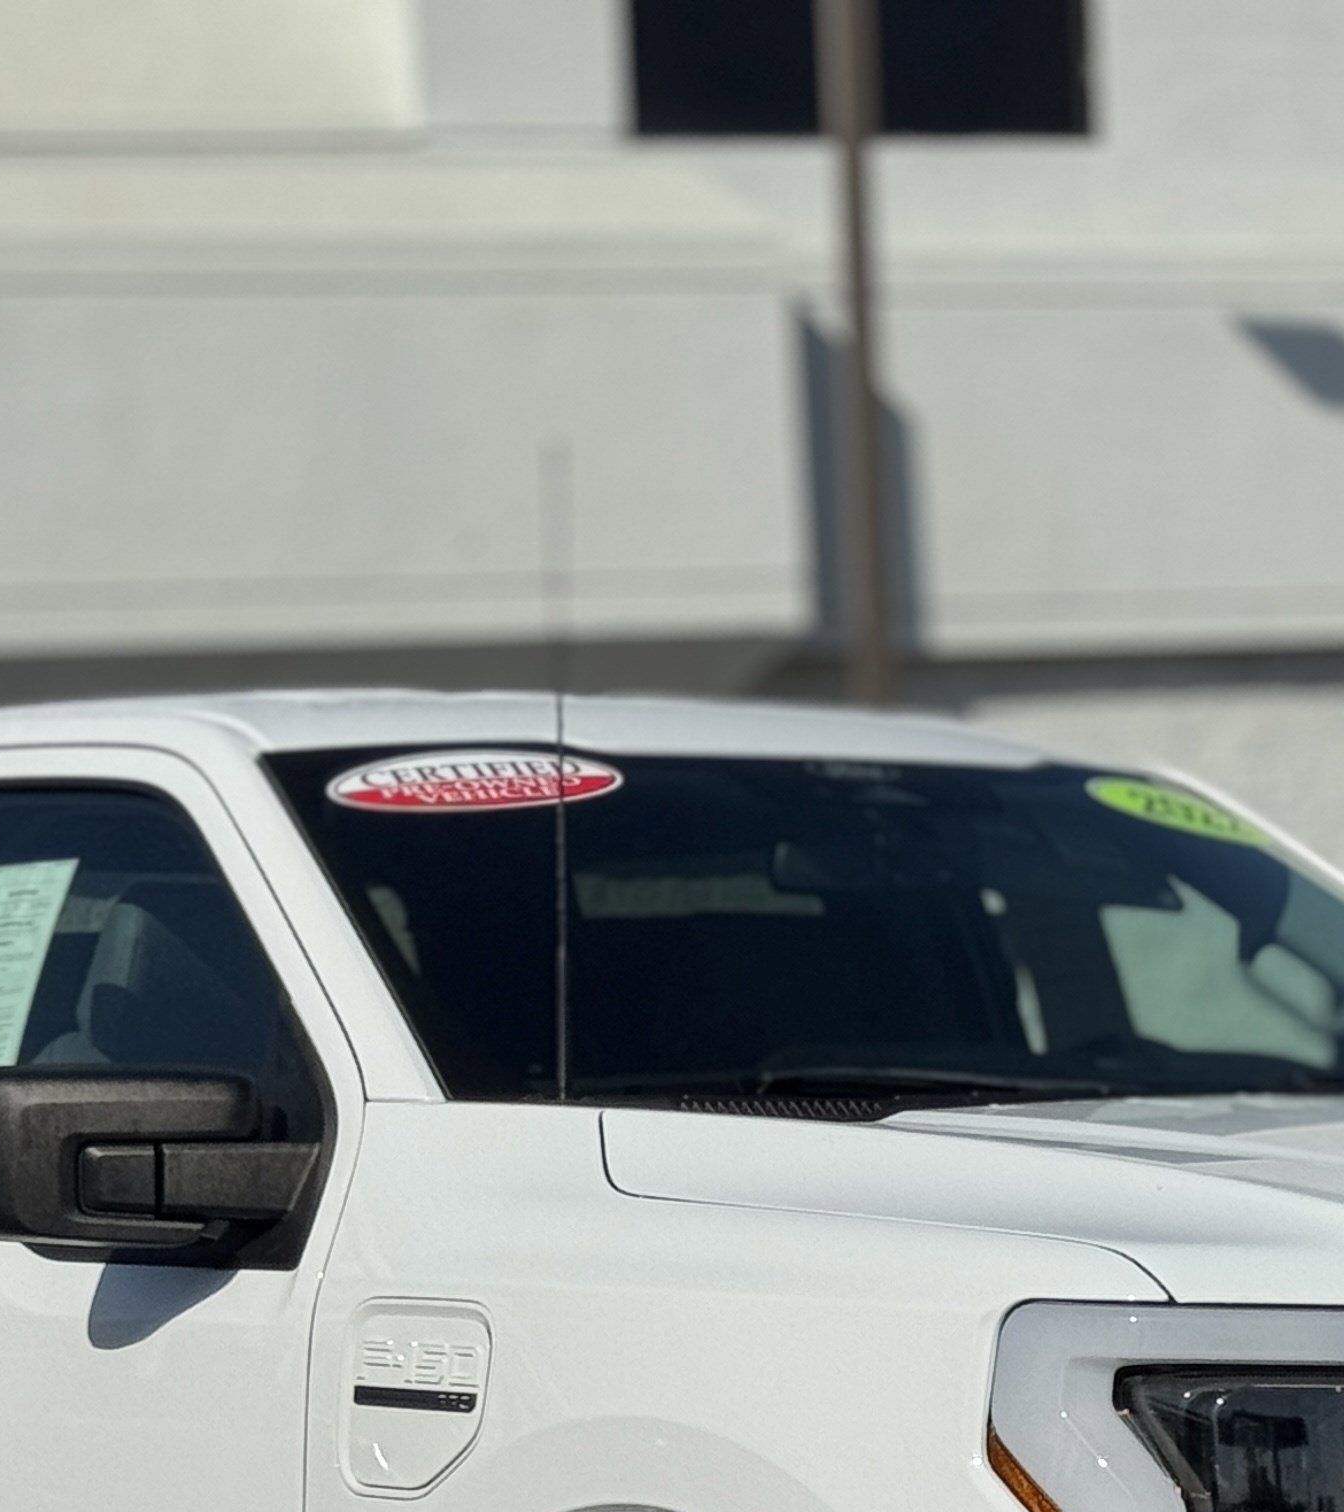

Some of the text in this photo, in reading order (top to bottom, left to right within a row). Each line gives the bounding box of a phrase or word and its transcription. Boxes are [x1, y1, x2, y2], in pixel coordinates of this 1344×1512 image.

[360, 760, 581, 788] CERTIFIED
[379, 774, 582, 800] PRE-OWNED
[417, 785, 560, 804] VEHICLE
